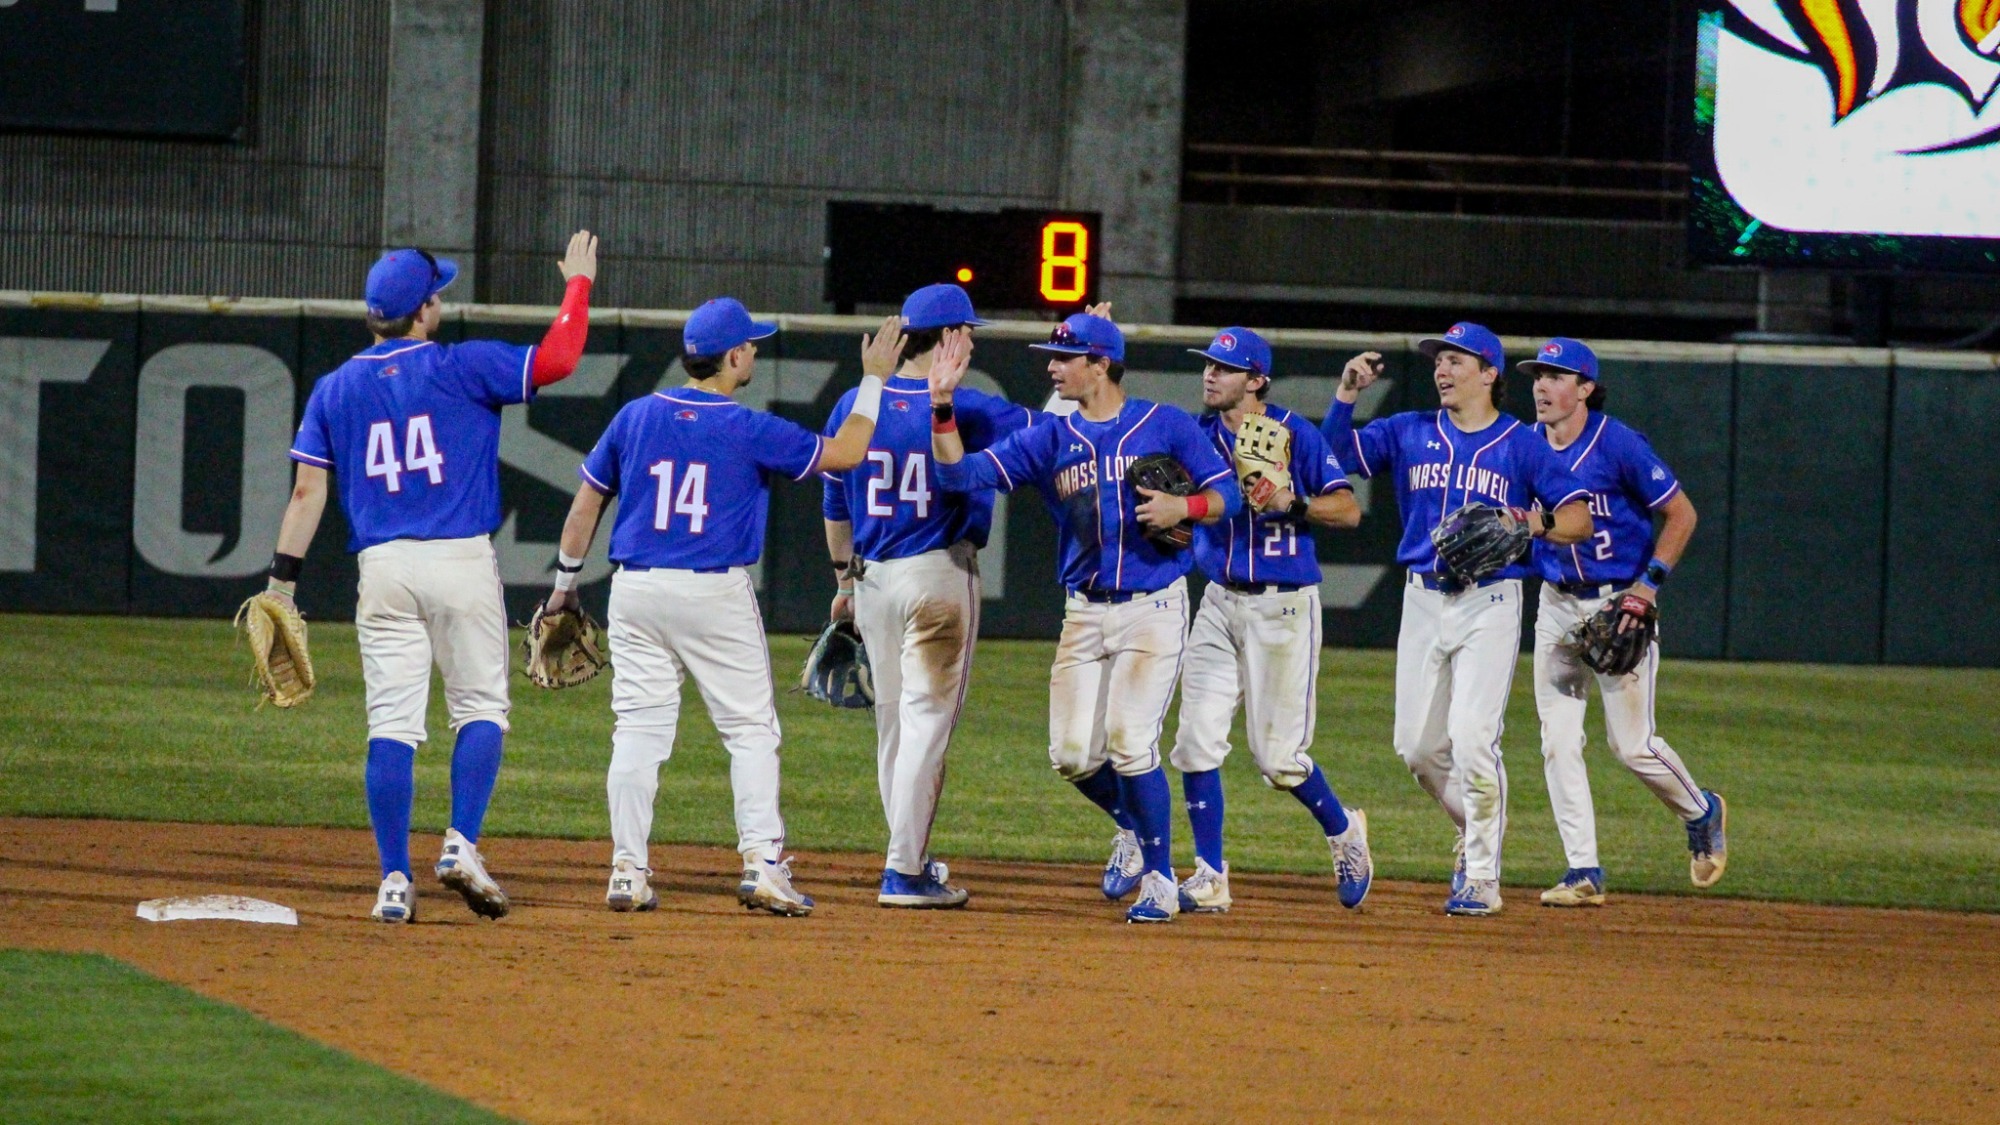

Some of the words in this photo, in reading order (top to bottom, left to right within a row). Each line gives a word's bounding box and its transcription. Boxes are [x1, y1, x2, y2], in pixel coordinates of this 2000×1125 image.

[1041, 221, 1087, 301] 8
[365, 414, 443, 493] 44
[867, 450, 931, 518] 24
[1456, 464, 1508, 504] LOWELL
[649, 460, 708, 533] 14
[1264, 522, 1296, 556] 21
[1593, 529, 1613, 561] 2
